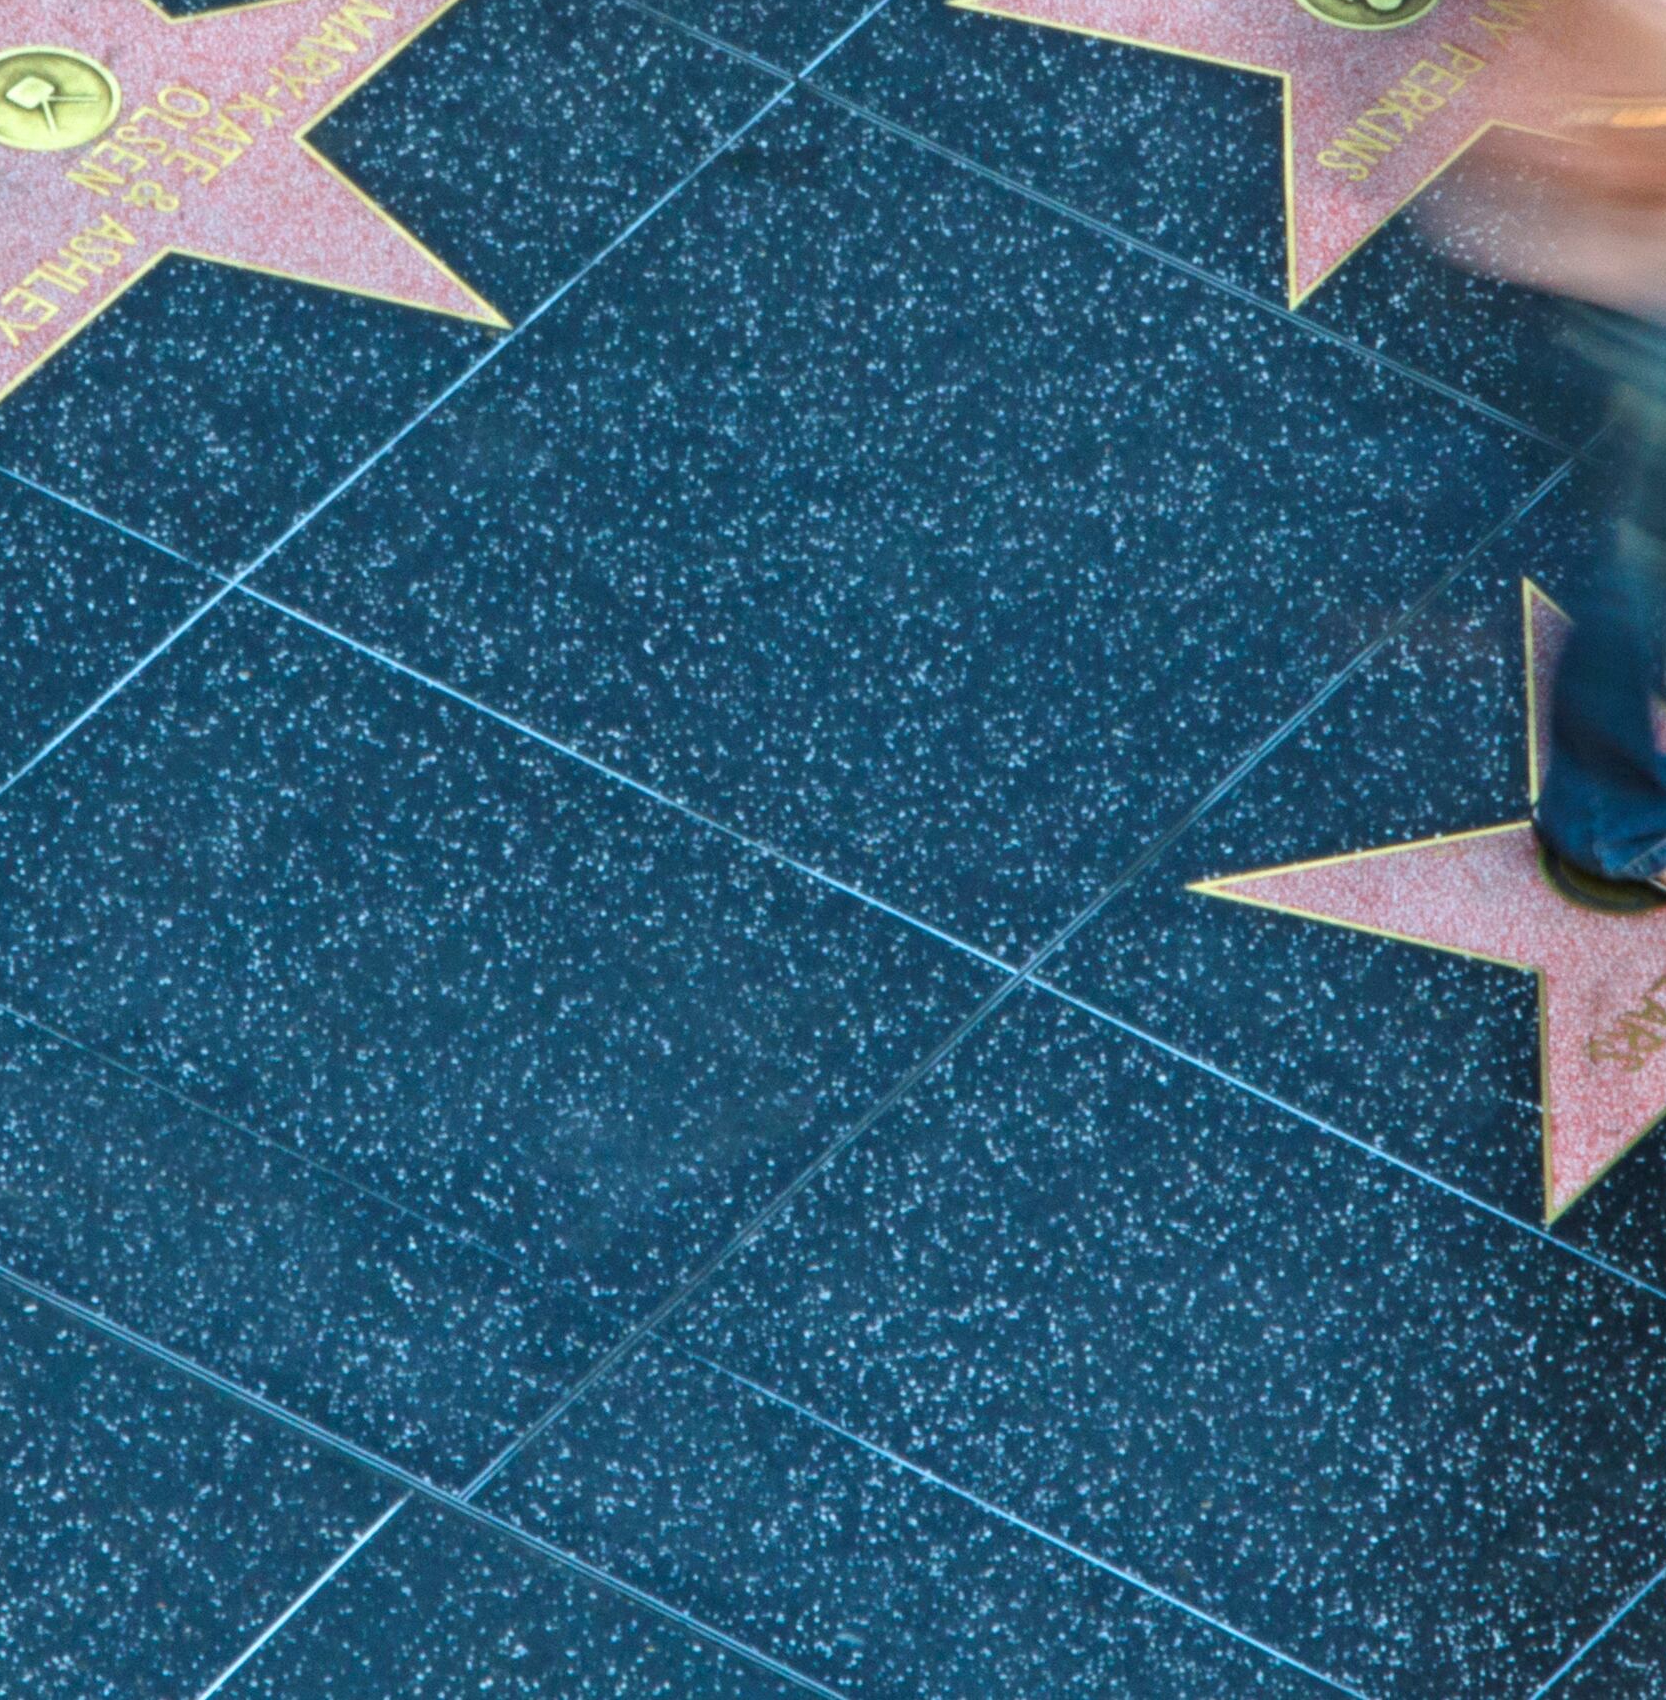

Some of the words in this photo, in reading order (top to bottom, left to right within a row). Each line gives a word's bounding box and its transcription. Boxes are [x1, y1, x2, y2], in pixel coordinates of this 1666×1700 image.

[65, 85, 211, 198] OLSEN
[1316, 41, 1487, 182] PERKINS
[121, 179, 180, 213] &
